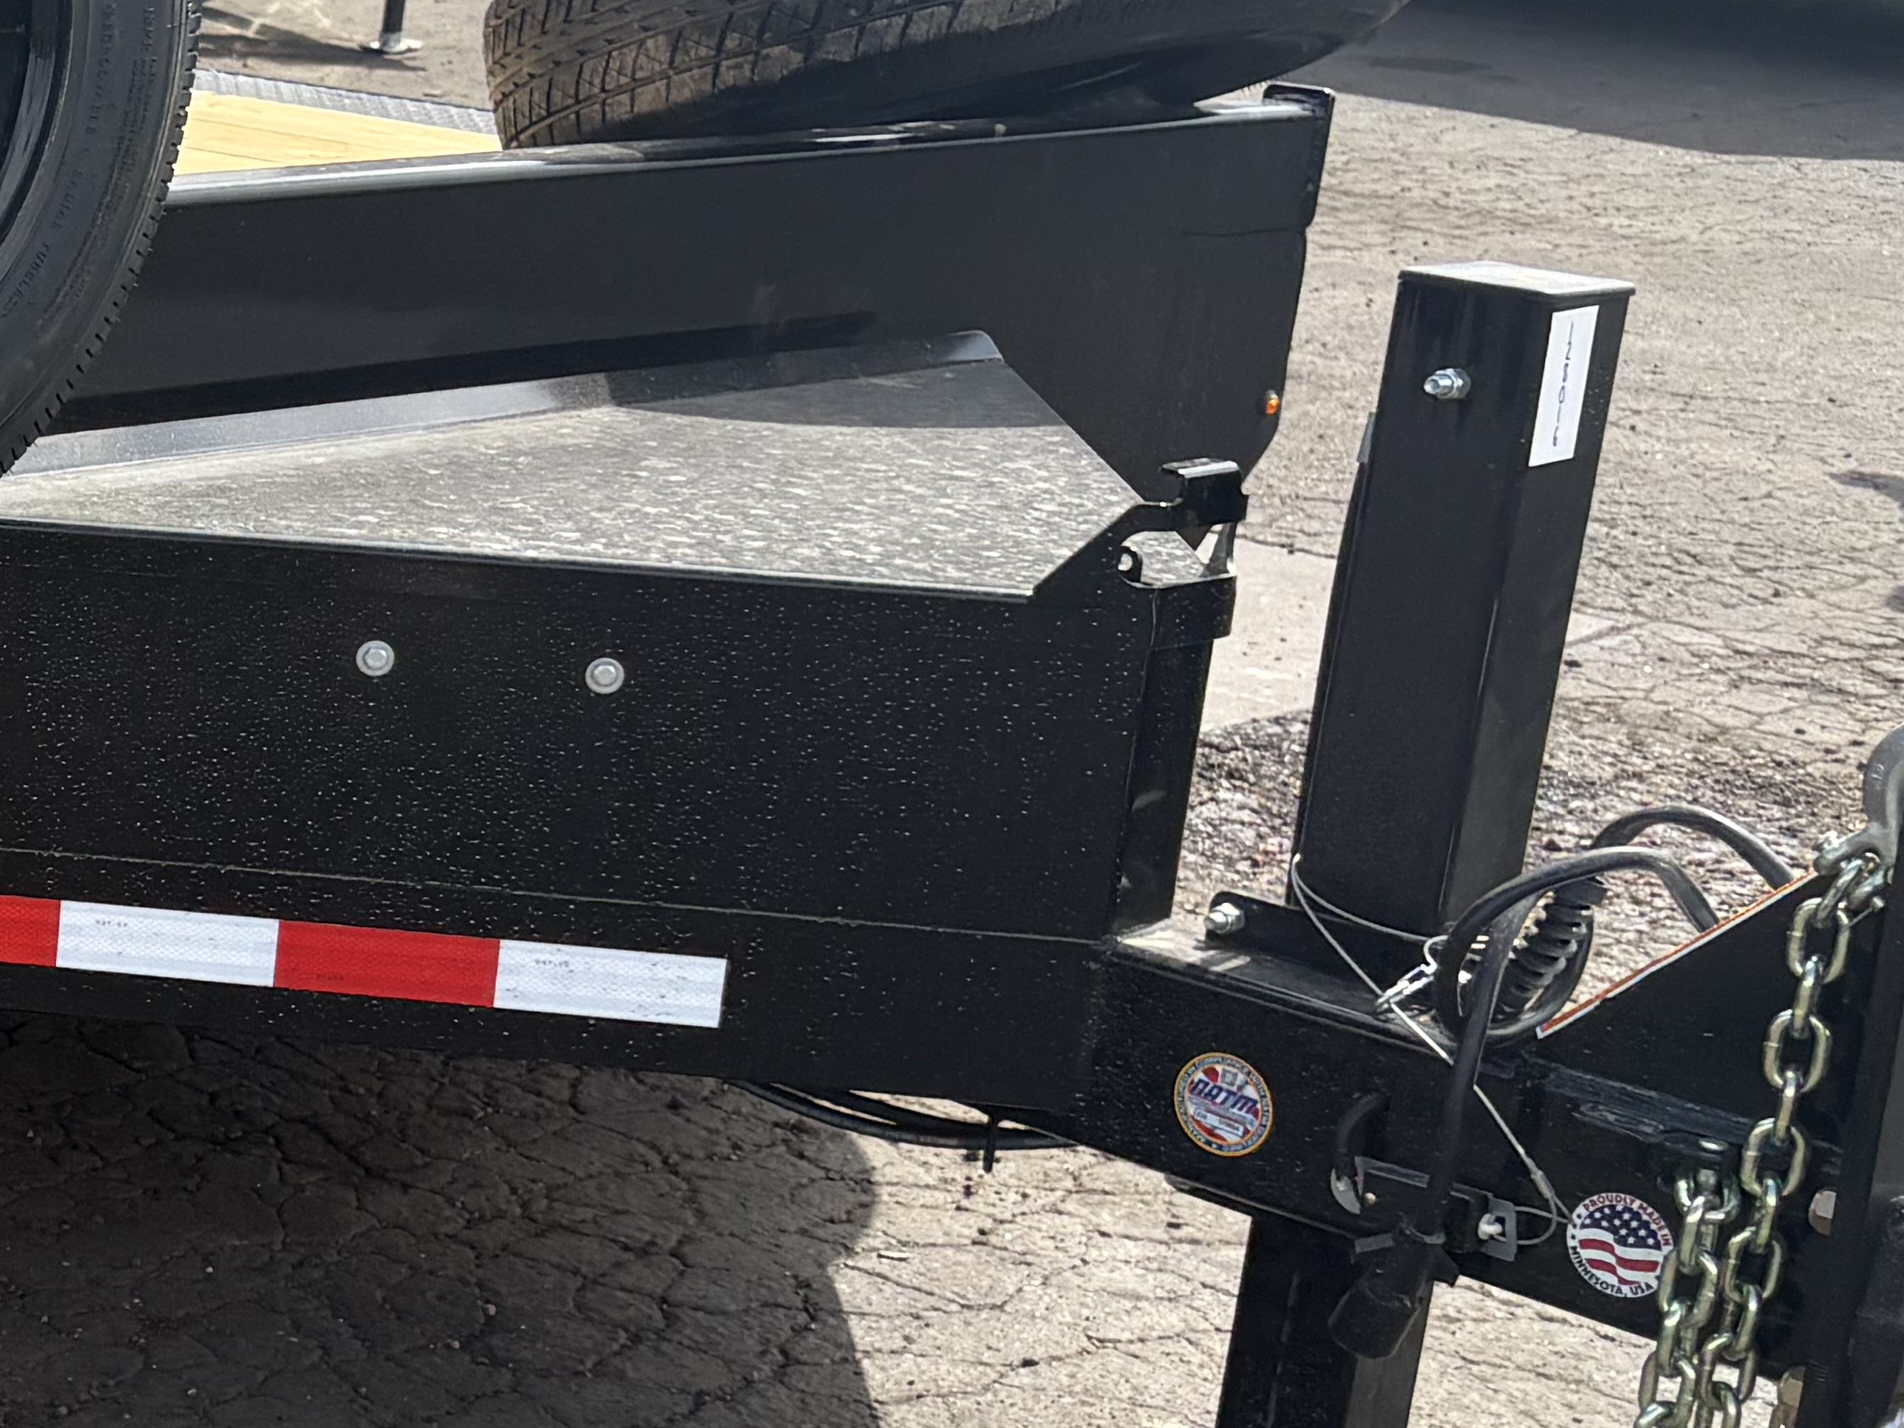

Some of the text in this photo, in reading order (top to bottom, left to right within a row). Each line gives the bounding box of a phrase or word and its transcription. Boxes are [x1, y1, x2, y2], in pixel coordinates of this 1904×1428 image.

[1582, 1194, 1672, 1247] PROUDLY MADE IN
[1570, 1245, 1654, 1298] MINNESOTA, USA
